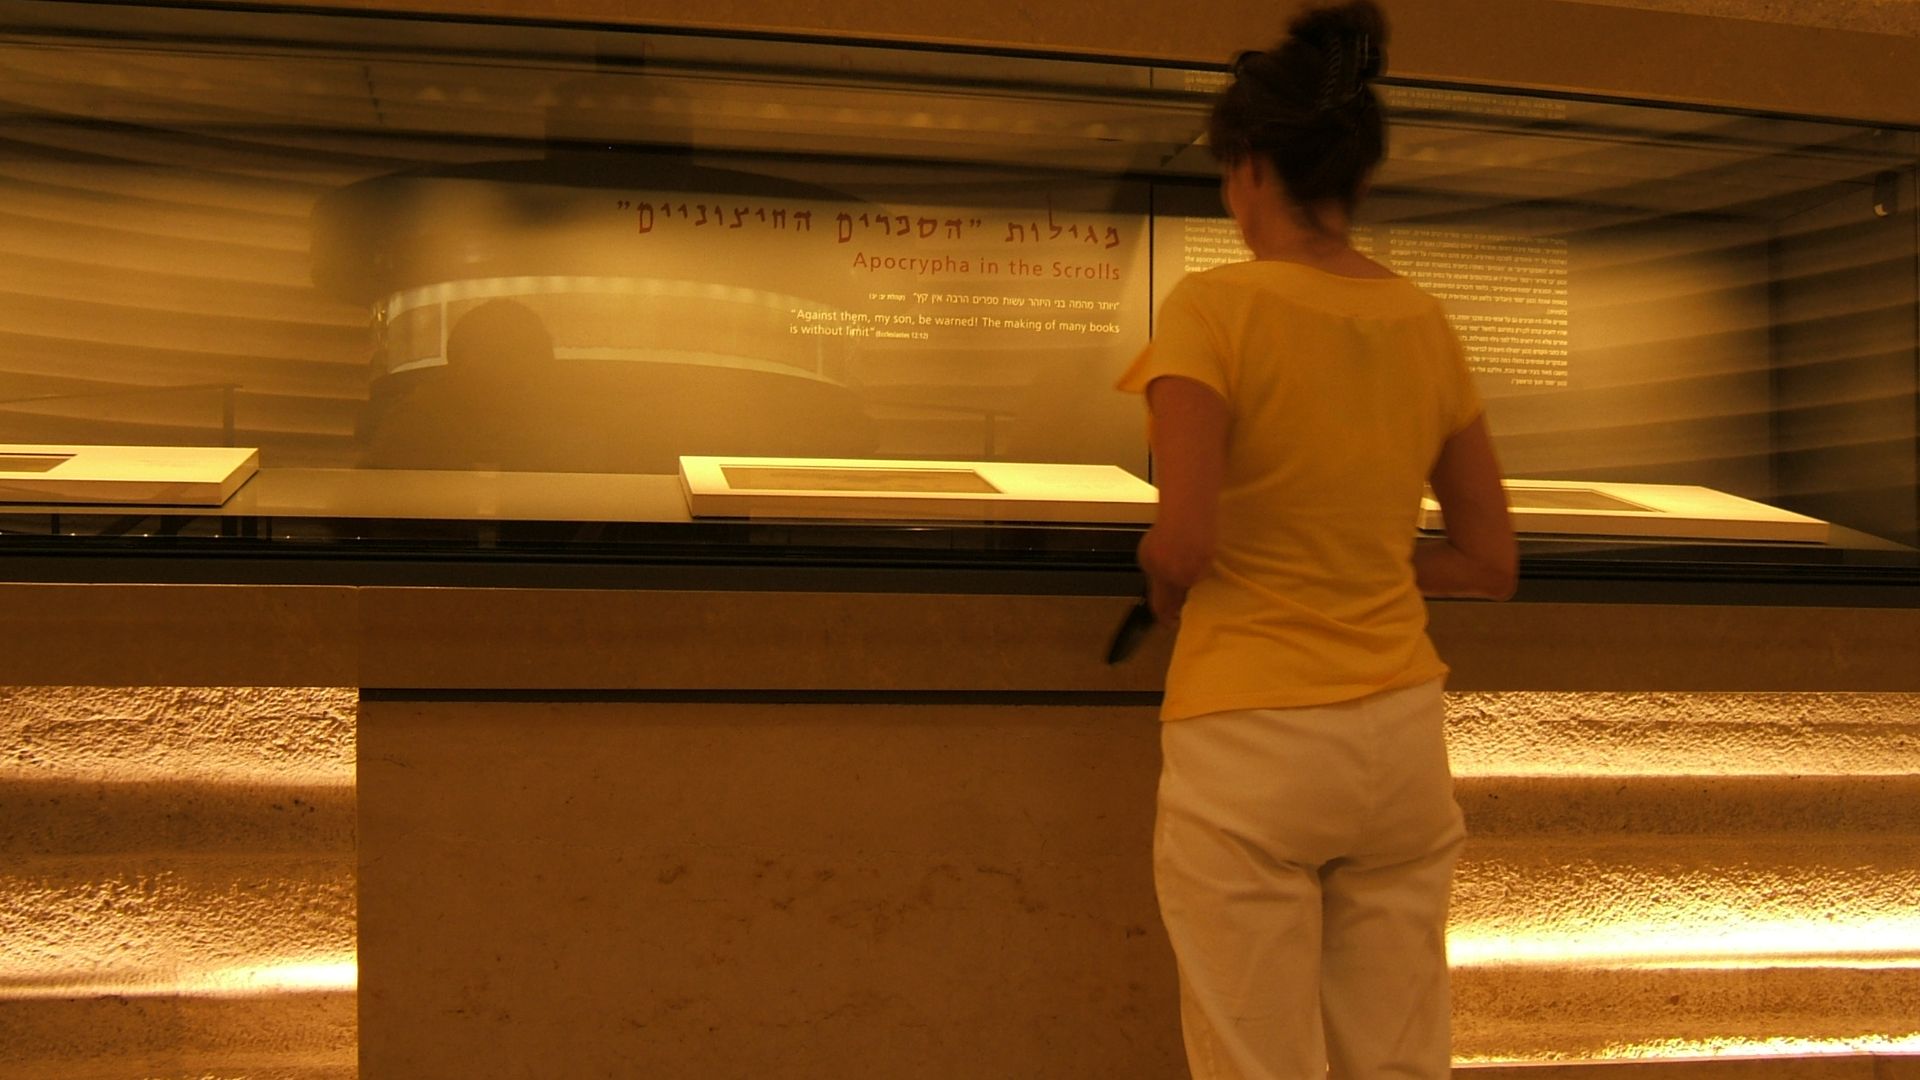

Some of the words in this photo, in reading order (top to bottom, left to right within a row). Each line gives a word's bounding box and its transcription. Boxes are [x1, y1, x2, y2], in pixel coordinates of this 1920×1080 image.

[1004, 196, 1120, 249] מגילות
[853, 252, 970, 275] Apocrypha
[980, 256, 999, 274] in
[1010, 259, 1043, 277] the
[1052, 261, 1120, 280] Scrolls
[790, 323, 798, 334] is
[801, 324, 842, 336] without
[840, 311, 871, 324] them,
[874, 314, 890, 325] my
[893, 314, 915, 325] son,
[918, 314, 932, 325] be
[935, 316, 978, 327] warned!
[982, 316, 1001, 328] The
[1004, 318, 1042, 332] making
[1045, 318, 1056, 330] of
[1059, 321, 1087, 333] many
[1089, 322, 1120, 334] books
